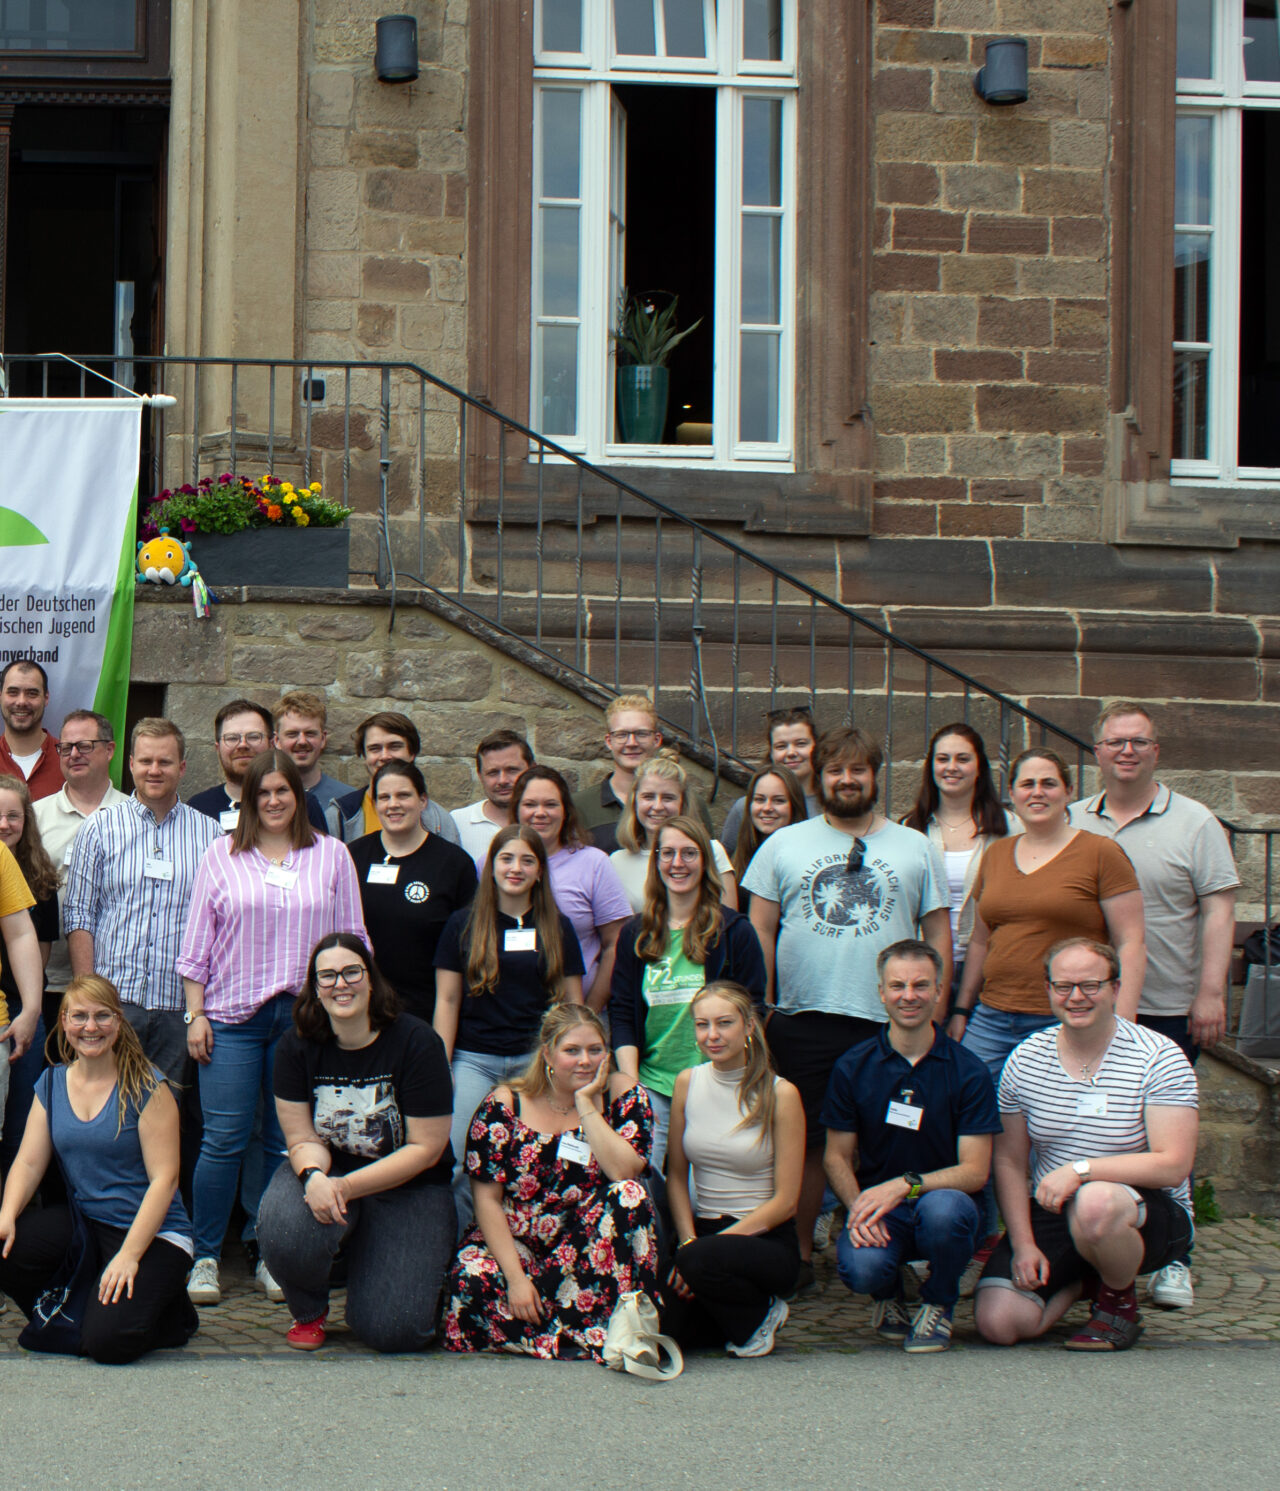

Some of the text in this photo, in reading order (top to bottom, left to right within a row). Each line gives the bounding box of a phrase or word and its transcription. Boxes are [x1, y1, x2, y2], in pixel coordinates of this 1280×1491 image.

[26, 594, 96, 612] Deutschen
[48, 616, 96, 638] Jugend
[800, 853, 899, 892] CALIFORN BEACH
[812, 922, 845, 938] SURF
[854, 920, 880, 938] AND
[880, 897, 897, 922] SUN
